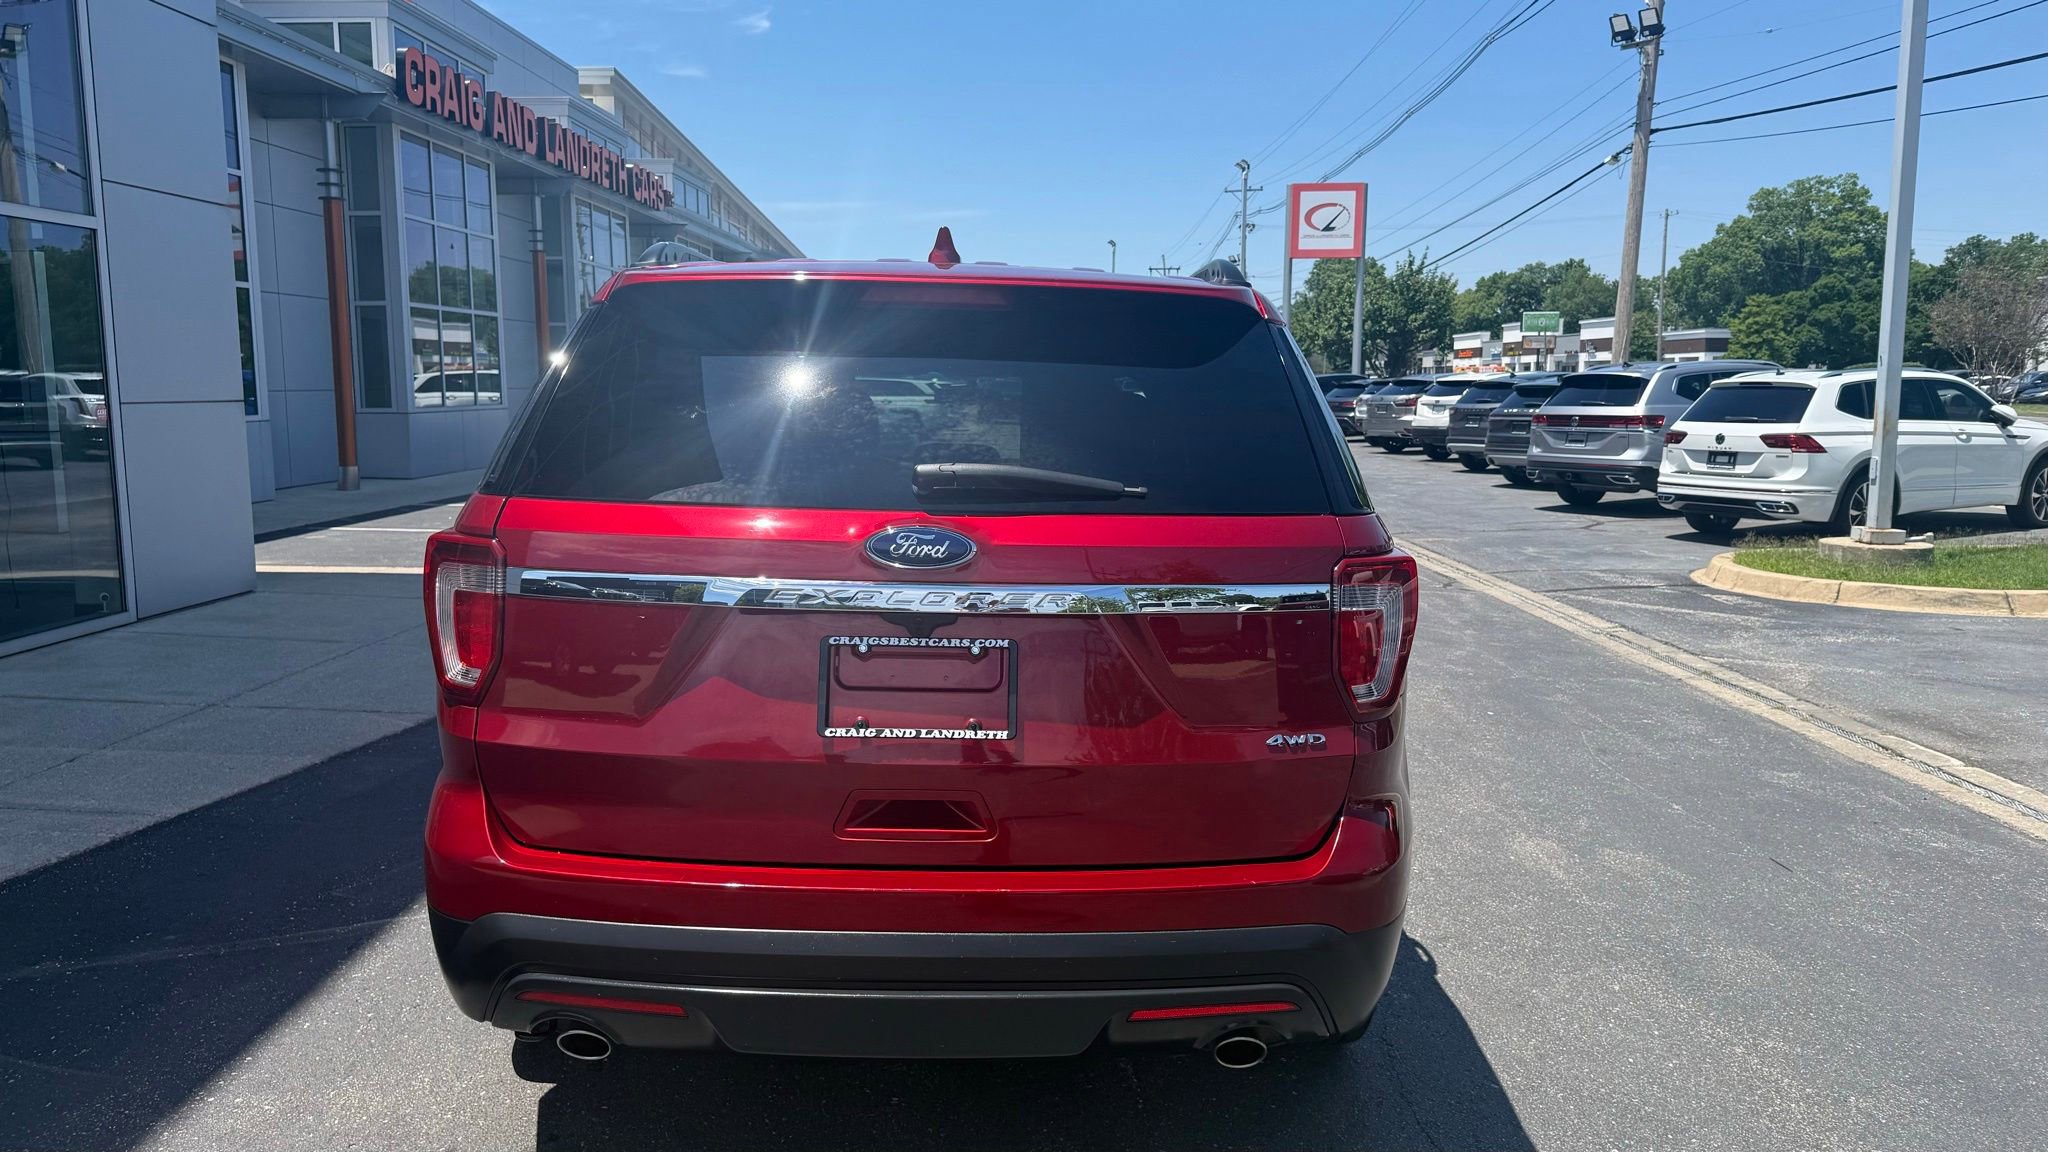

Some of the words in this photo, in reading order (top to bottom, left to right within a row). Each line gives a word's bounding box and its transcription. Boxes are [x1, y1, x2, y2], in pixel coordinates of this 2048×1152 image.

[403, 46, 485, 132] CRAIG
[492, 91, 538, 156] AND
[544, 116, 629, 198] LANDRETH
[632, 163, 665, 211] CARS
[889, 532, 950, 558] Ford
[763, 587, 1073, 609] EXPLORER
[828, 636, 1010, 648] CRAIGSBESTCARS.COM
[824, 727, 878, 738] CRAIG
[880, 729, 917, 739] AND
[919, 729, 1009, 740] LANDRETH
[1265, 733, 1326, 747] 4WD
